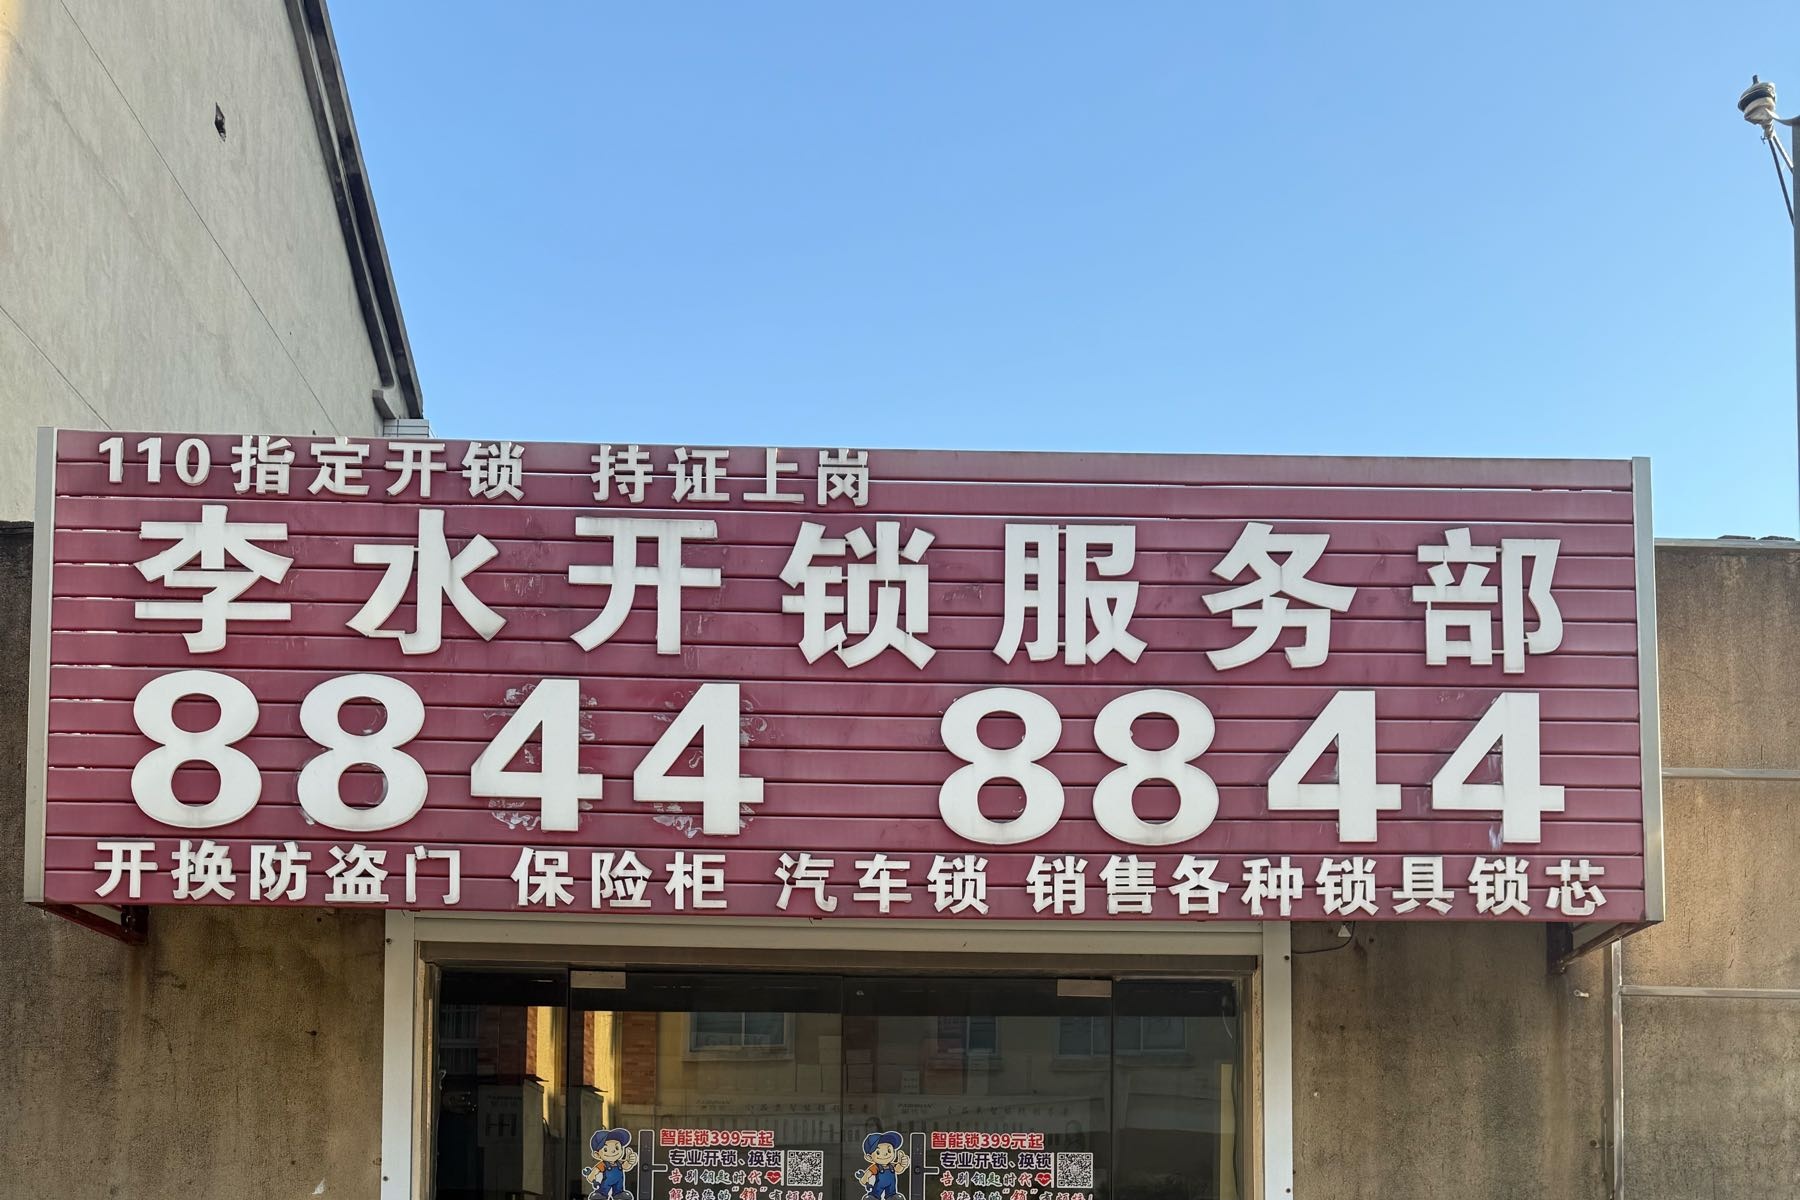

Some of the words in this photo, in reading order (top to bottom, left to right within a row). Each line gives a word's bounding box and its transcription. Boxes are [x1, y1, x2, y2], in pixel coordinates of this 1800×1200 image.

[98, 434, 525, 501] 110指定开锁
[591, 445, 871, 507] 持证上岗
[134, 504, 1565, 674] 李水开锁服务部
[131, 670, 764, 836] 8844
[938, 687, 1566, 846] 8844
[94, 840, 462, 906] 开换防盗门
[511, 847, 728, 910] 保险柜
[775, 852, 988, 915] 汽车锁
[1026, 854, 1608, 917] 销售各种锁具锁芯
[660, 1129, 775, 1148] 智能锁399元起
[931, 1132, 1045, 1149] 智能锁399元起
[668, 1150, 782, 1167] 专业开锁、换锁
[940, 1152, 1052, 1169] 专业开锁、换锁
[668, 1168, 763, 1185] 告别钥匙时代
[940, 1170, 1033, 1187] 告别钥匙时代
